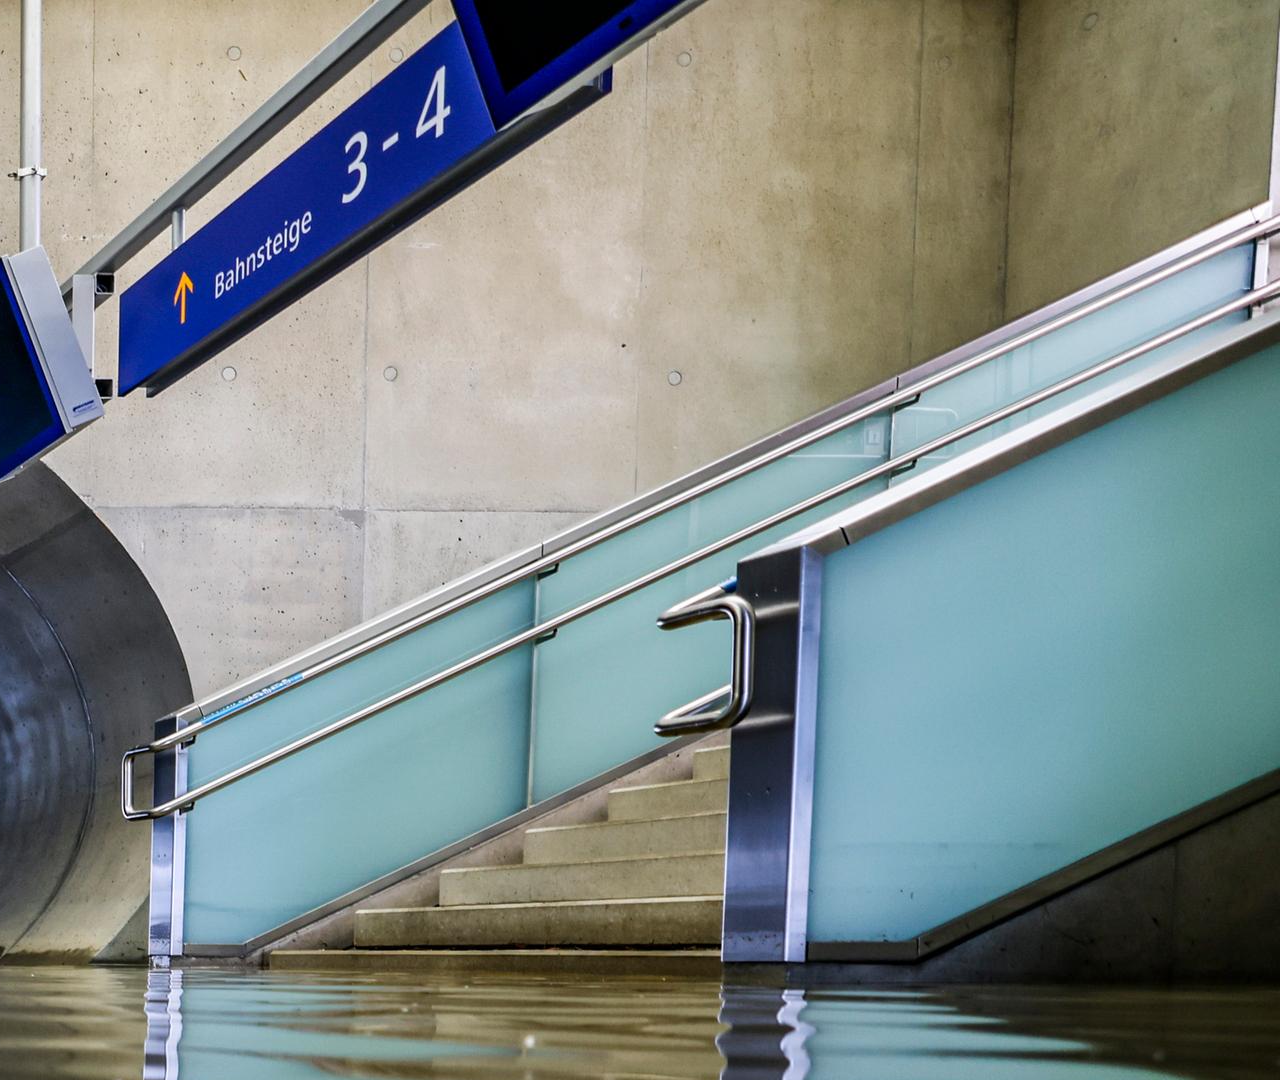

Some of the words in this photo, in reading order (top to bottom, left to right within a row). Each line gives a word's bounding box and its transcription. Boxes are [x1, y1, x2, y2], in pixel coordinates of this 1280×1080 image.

[215, 211, 312, 299] Bahnsteige
[342, 131, 368, 204] 3
[415, 65, 451, 139] 4
